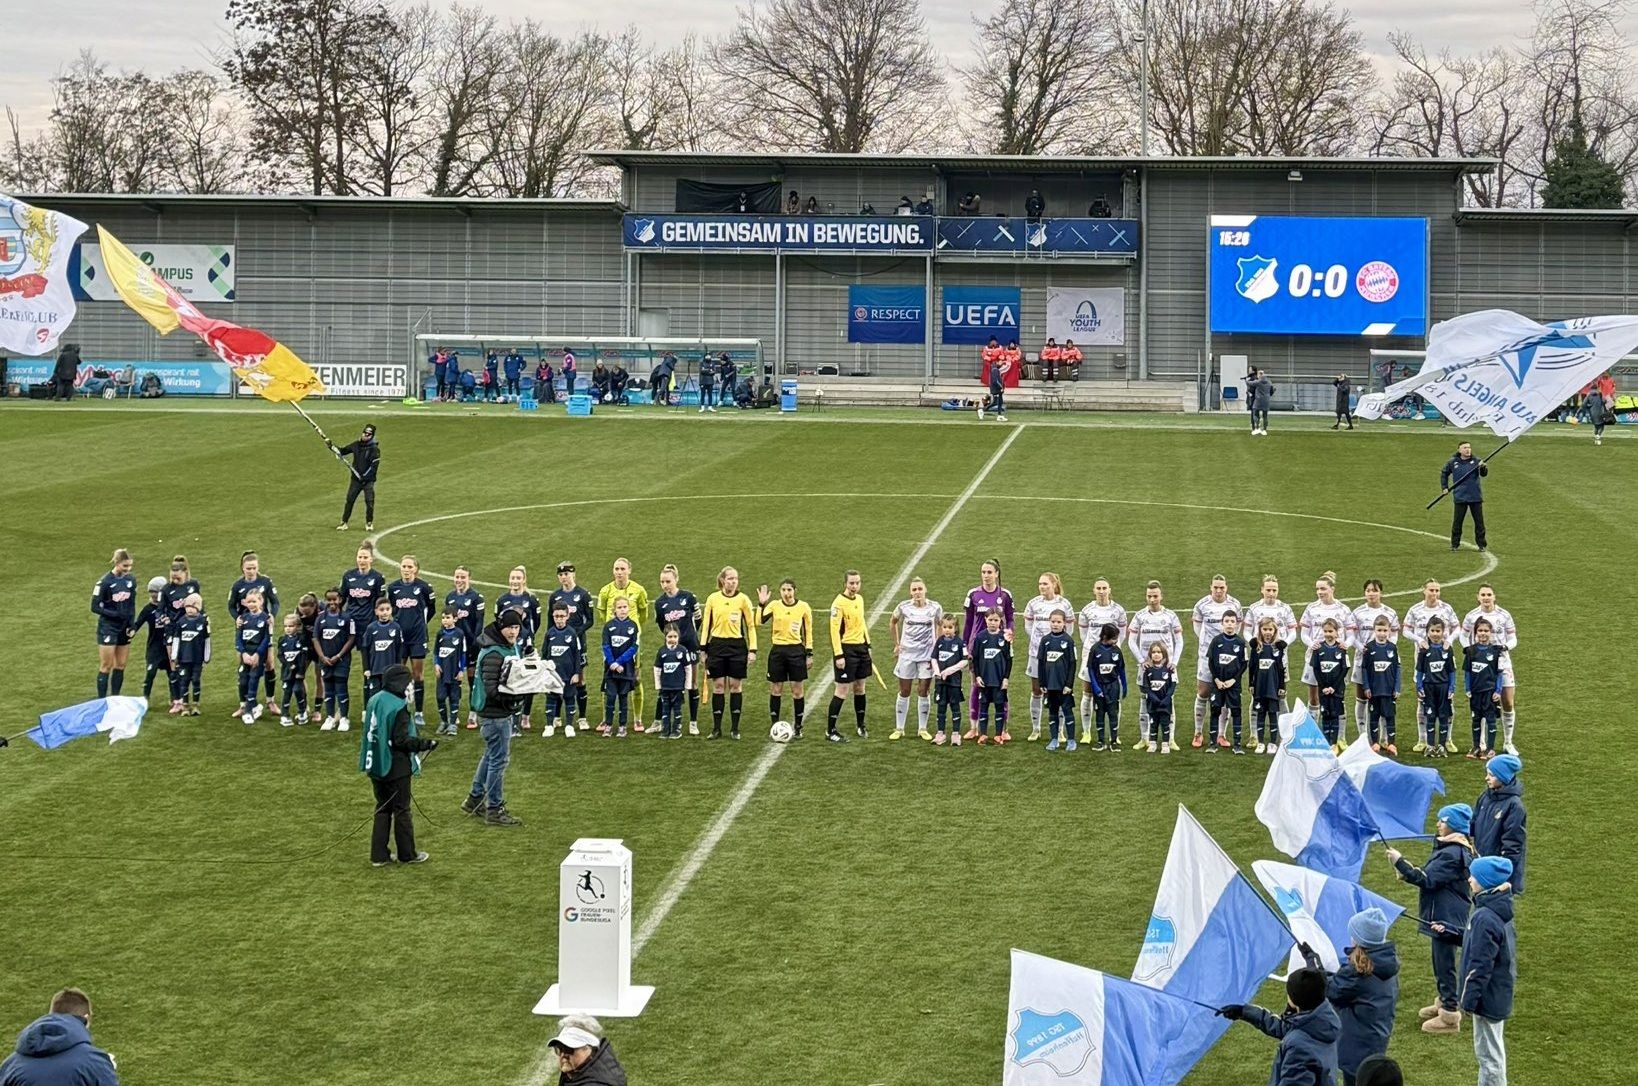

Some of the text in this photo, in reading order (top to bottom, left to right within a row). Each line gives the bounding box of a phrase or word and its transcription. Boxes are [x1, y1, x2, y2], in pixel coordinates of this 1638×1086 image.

[662, 222, 924, 244] GEMEINSAM IN BEWEGUNG.
[151, 268, 194, 280] AMPUS
[1288, 264, 1348, 298] 0:0
[871, 309, 920, 320] RESPECT
[946, 305, 1016, 326] UEFA
[1069, 319, 1101, 327] YOUTH
